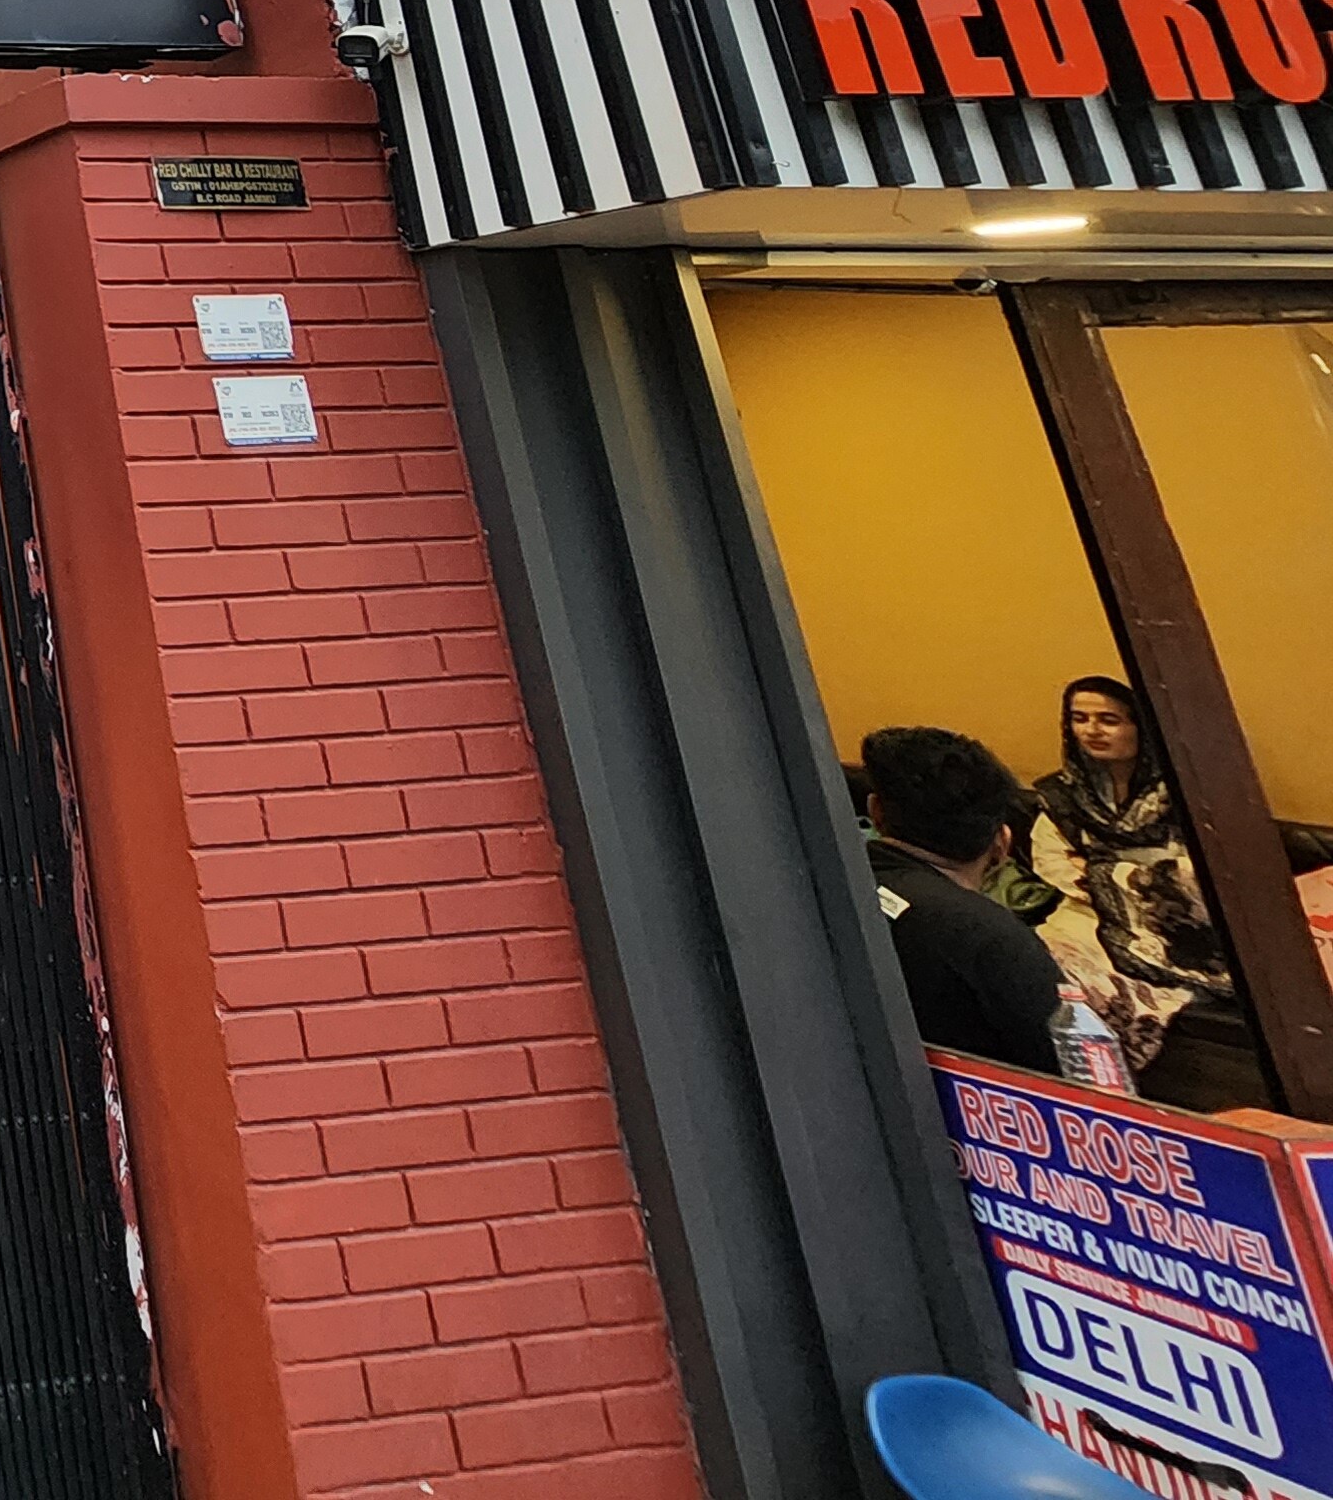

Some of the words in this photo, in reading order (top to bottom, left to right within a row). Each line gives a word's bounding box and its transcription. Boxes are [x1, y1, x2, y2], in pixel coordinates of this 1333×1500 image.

[158, 163, 178, 178] RED
[179, 163, 212, 178] CHILLY
[213, 164, 234, 178] BAR
[235, 164, 243, 178] &
[244, 164, 299, 179] RESTAURANT
[215, 194, 242, 203] ROAD
[953, 1080, 1051, 1159] RED
[1054, 1107, 1206, 1208] ROSE
[969, 1193, 1077, 1260] SLEEPER
[1082, 1229, 1107, 1266] &
[1105, 1237, 1201, 1298] VOLVO
[1203, 1271, 1313, 1336] COACH
[1029, 1162, 1112, 1226] AND
[1112, 1187, 1296, 1287] TRAVEL
[1033, 1293, 1263, 1440] DELHI
